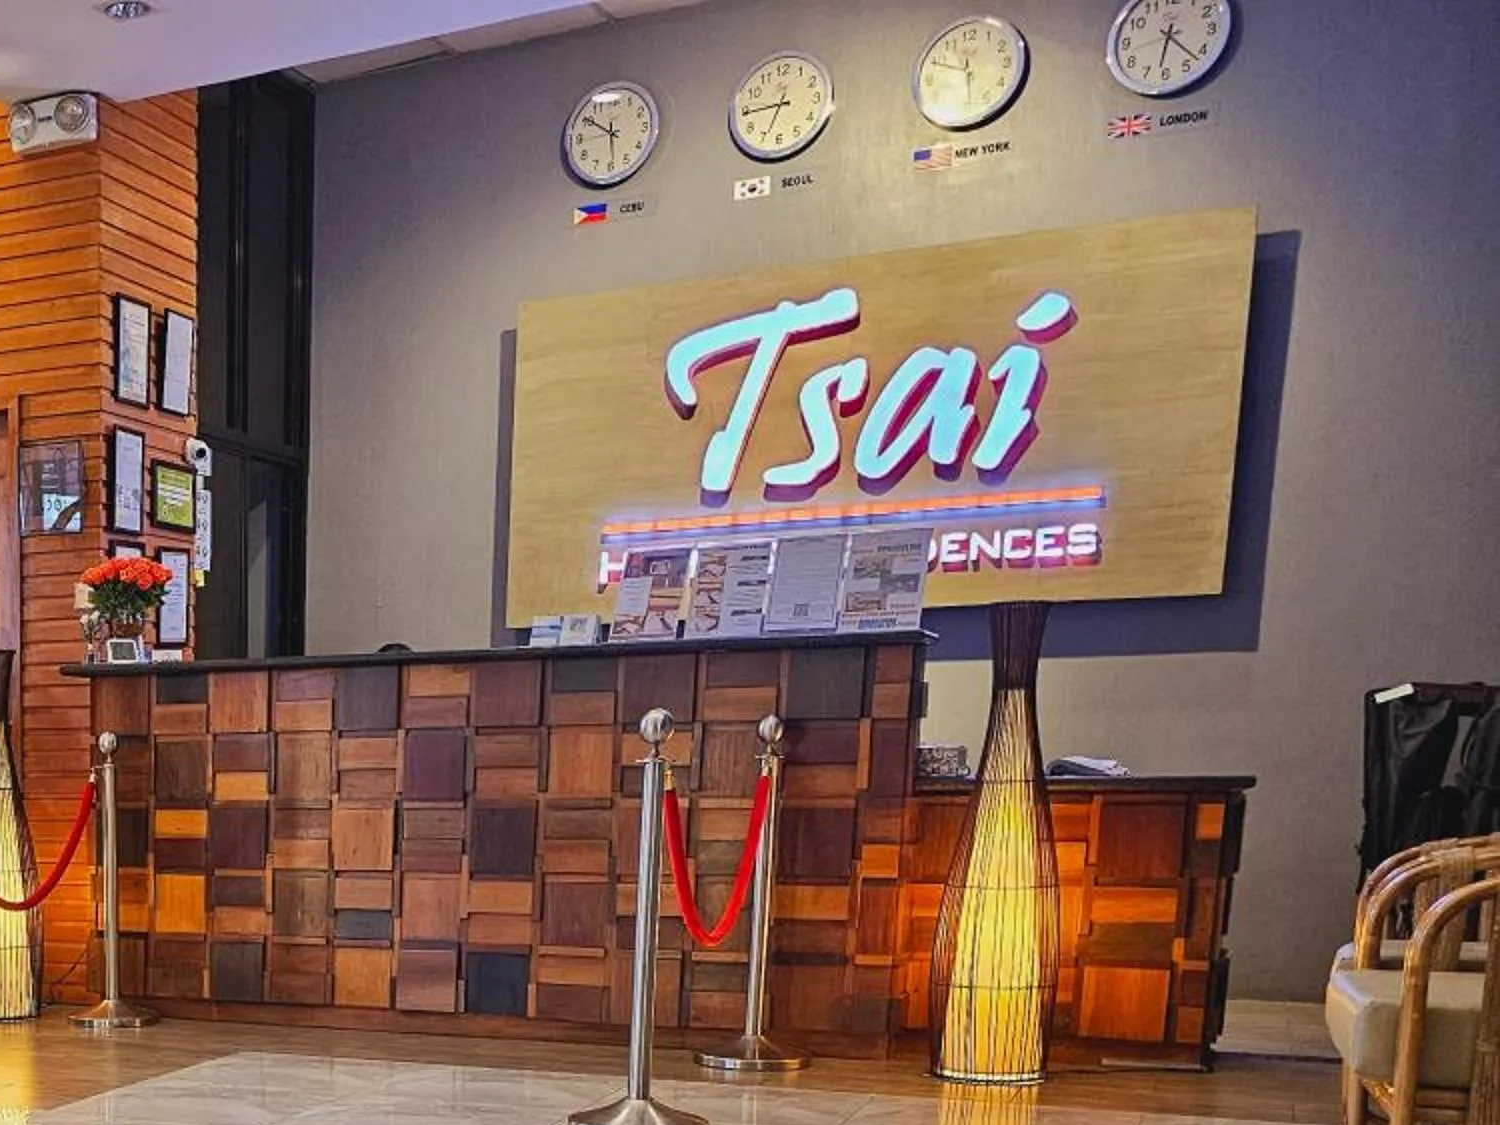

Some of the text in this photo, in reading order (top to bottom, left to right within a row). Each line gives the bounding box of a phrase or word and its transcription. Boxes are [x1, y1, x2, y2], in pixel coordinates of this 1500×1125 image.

[1201, 5, 1212, 18] 2
[1130, 17, 1147, 31] 10
[1207, 22, 1216, 35] 3
[1198, 43, 1208, 55] 4
[776, 63, 790, 76] 12
[1142, 66, 1151, 79] 7
[1161, 67, 1171, 80] 6
[806, 75, 816, 88] 2
[748, 87, 762, 100] 10
[1159, 110, 1209, 127] LONDON
[955, 141, 1011, 158] NEW YORK
[781, 174, 815, 188] SEOUL
[619, 201, 645, 213] CEBU
[664, 287, 1076, 505] Tsai
[928, 523, 1100, 570] ENCES
